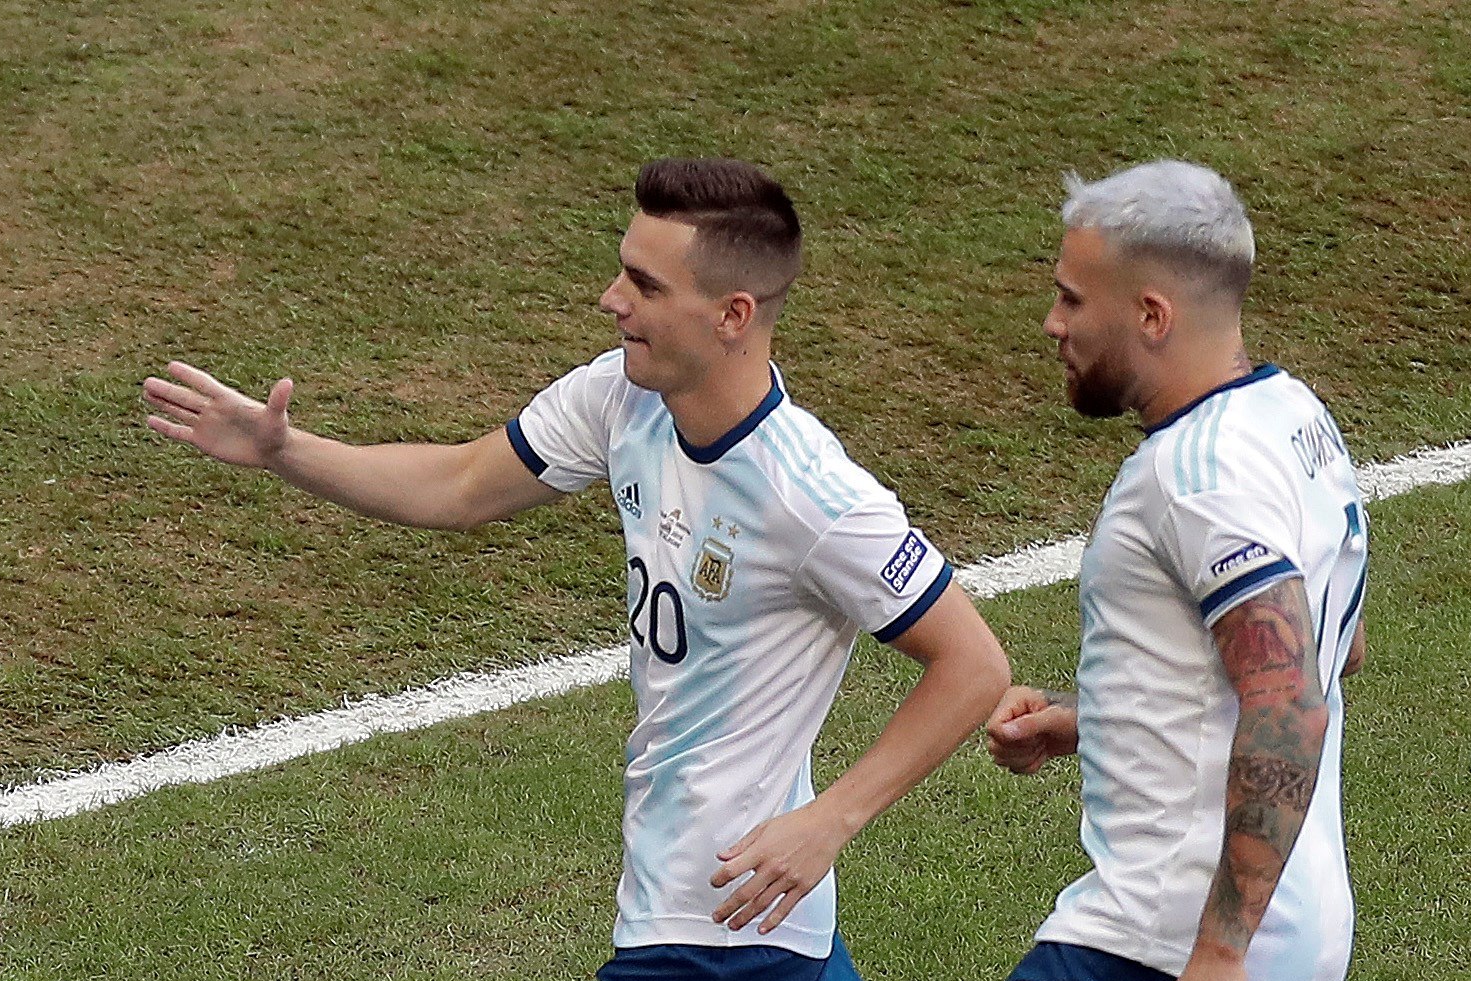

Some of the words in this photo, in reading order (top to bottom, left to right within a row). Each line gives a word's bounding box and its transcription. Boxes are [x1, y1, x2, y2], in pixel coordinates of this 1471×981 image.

[883, 551, 907, 580] Cree
[904, 535, 918, 553] en
[892, 545, 923, 590] grande
[628, 556, 689, 665] 20
